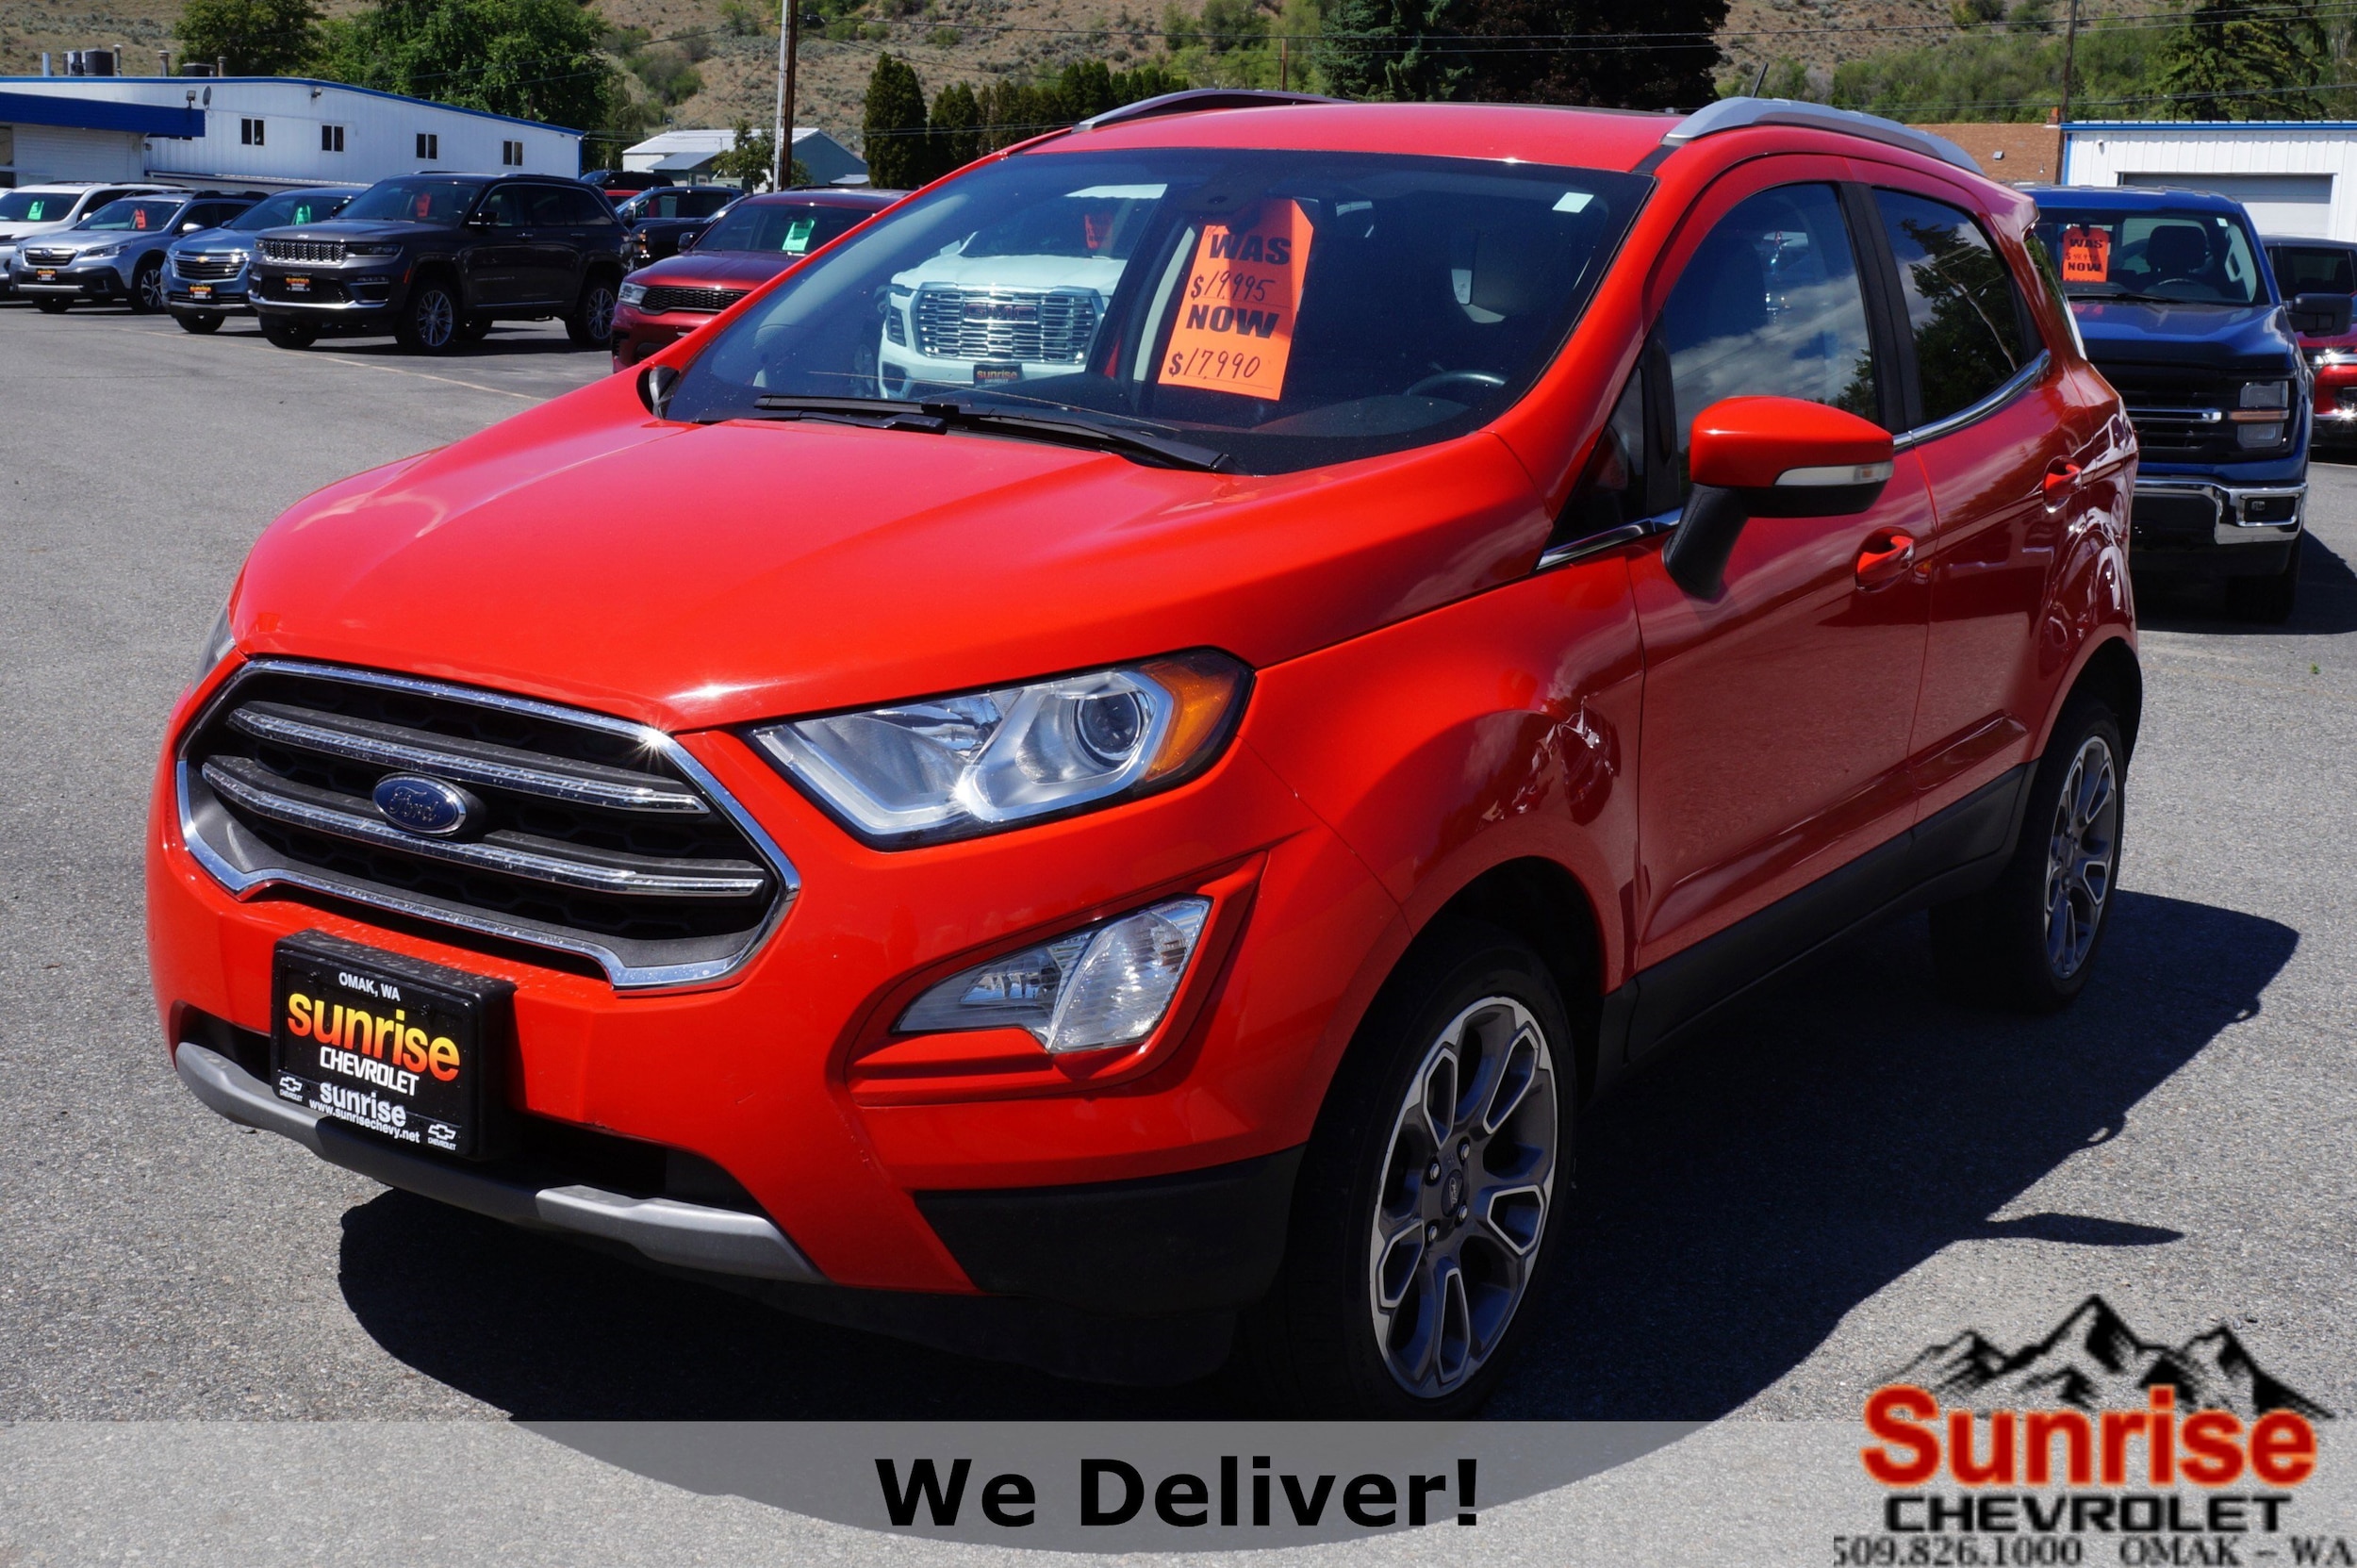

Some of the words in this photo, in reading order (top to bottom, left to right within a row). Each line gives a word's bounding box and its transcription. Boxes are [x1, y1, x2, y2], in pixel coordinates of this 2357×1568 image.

[1209, 234, 1292, 265] WAS
[2069, 239, 2103, 248] WAS
[2068, 262, 2102, 272] NOW
[964, 303, 1036, 321] GMC
[1185, 304, 1280, 339] NOW
[976, 369, 1018, 379] sunrise
[338, 971, 379, 998] OMAK,
[380, 983, 401, 1002] WA
[288, 993, 461, 1081] sunrise
[319, 1046, 420, 1097] CHEVROLET
[319, 1081, 406, 1128] sunrise
[308, 1098, 420, 1144] www.sunrisechevy.net
